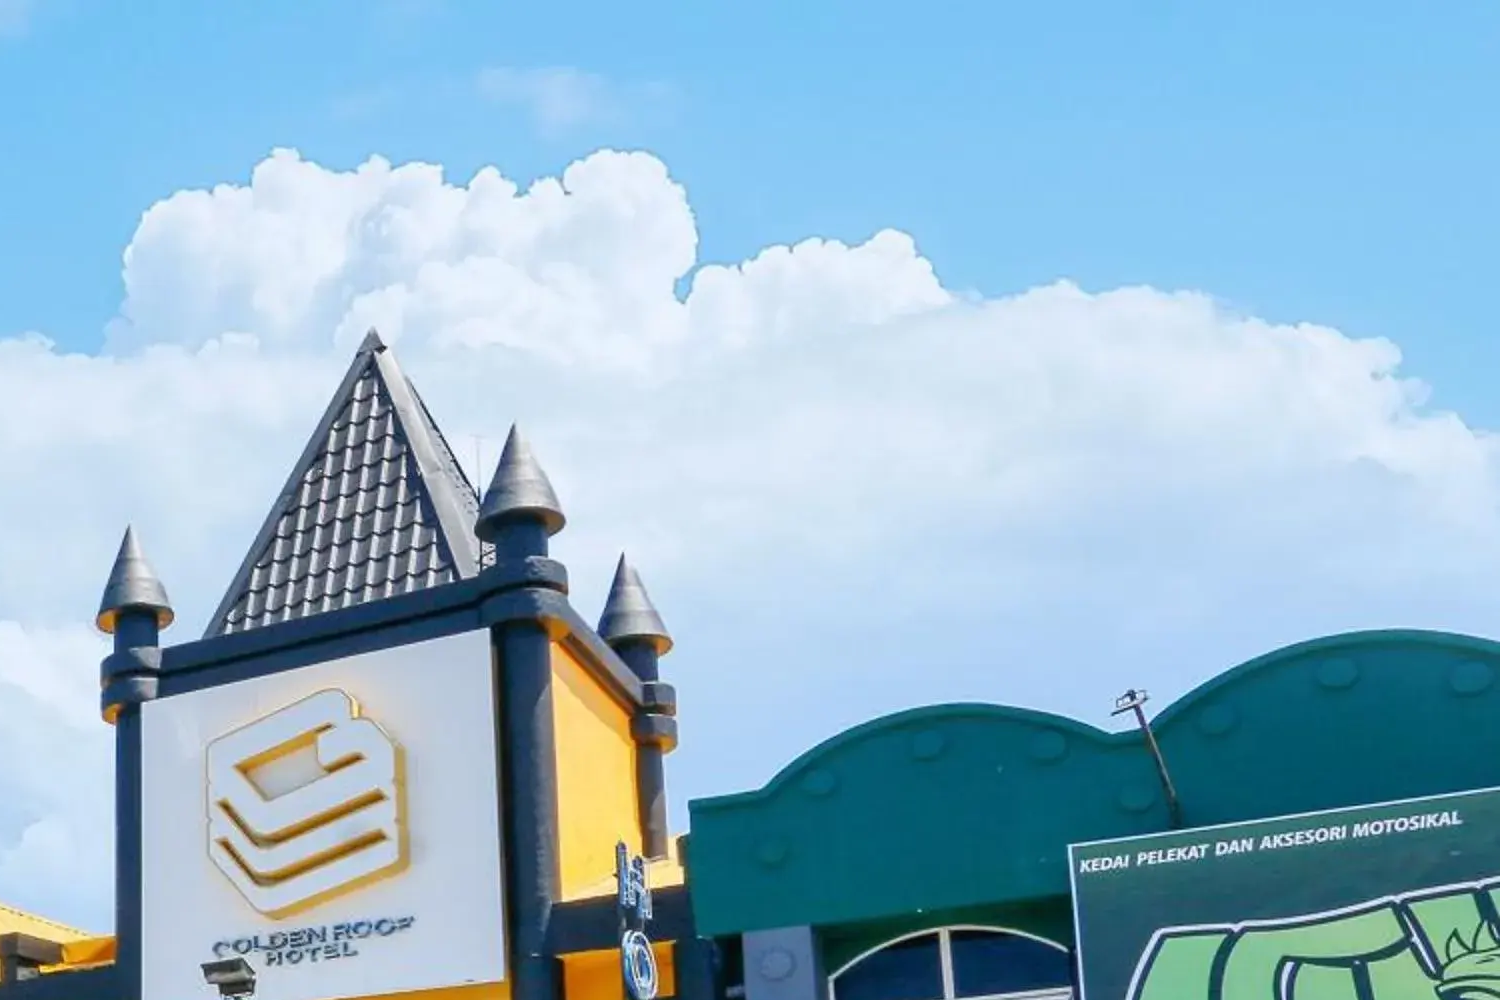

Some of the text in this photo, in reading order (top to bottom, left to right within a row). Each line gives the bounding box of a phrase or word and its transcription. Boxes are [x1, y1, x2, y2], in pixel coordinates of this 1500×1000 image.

[1079, 810, 1462, 873] KEDAI PELEKAT DAN AKSESORI MOTOSIKAL
[333, 916, 414, 941] ROOF
[266, 942, 358, 966] HOTEL
